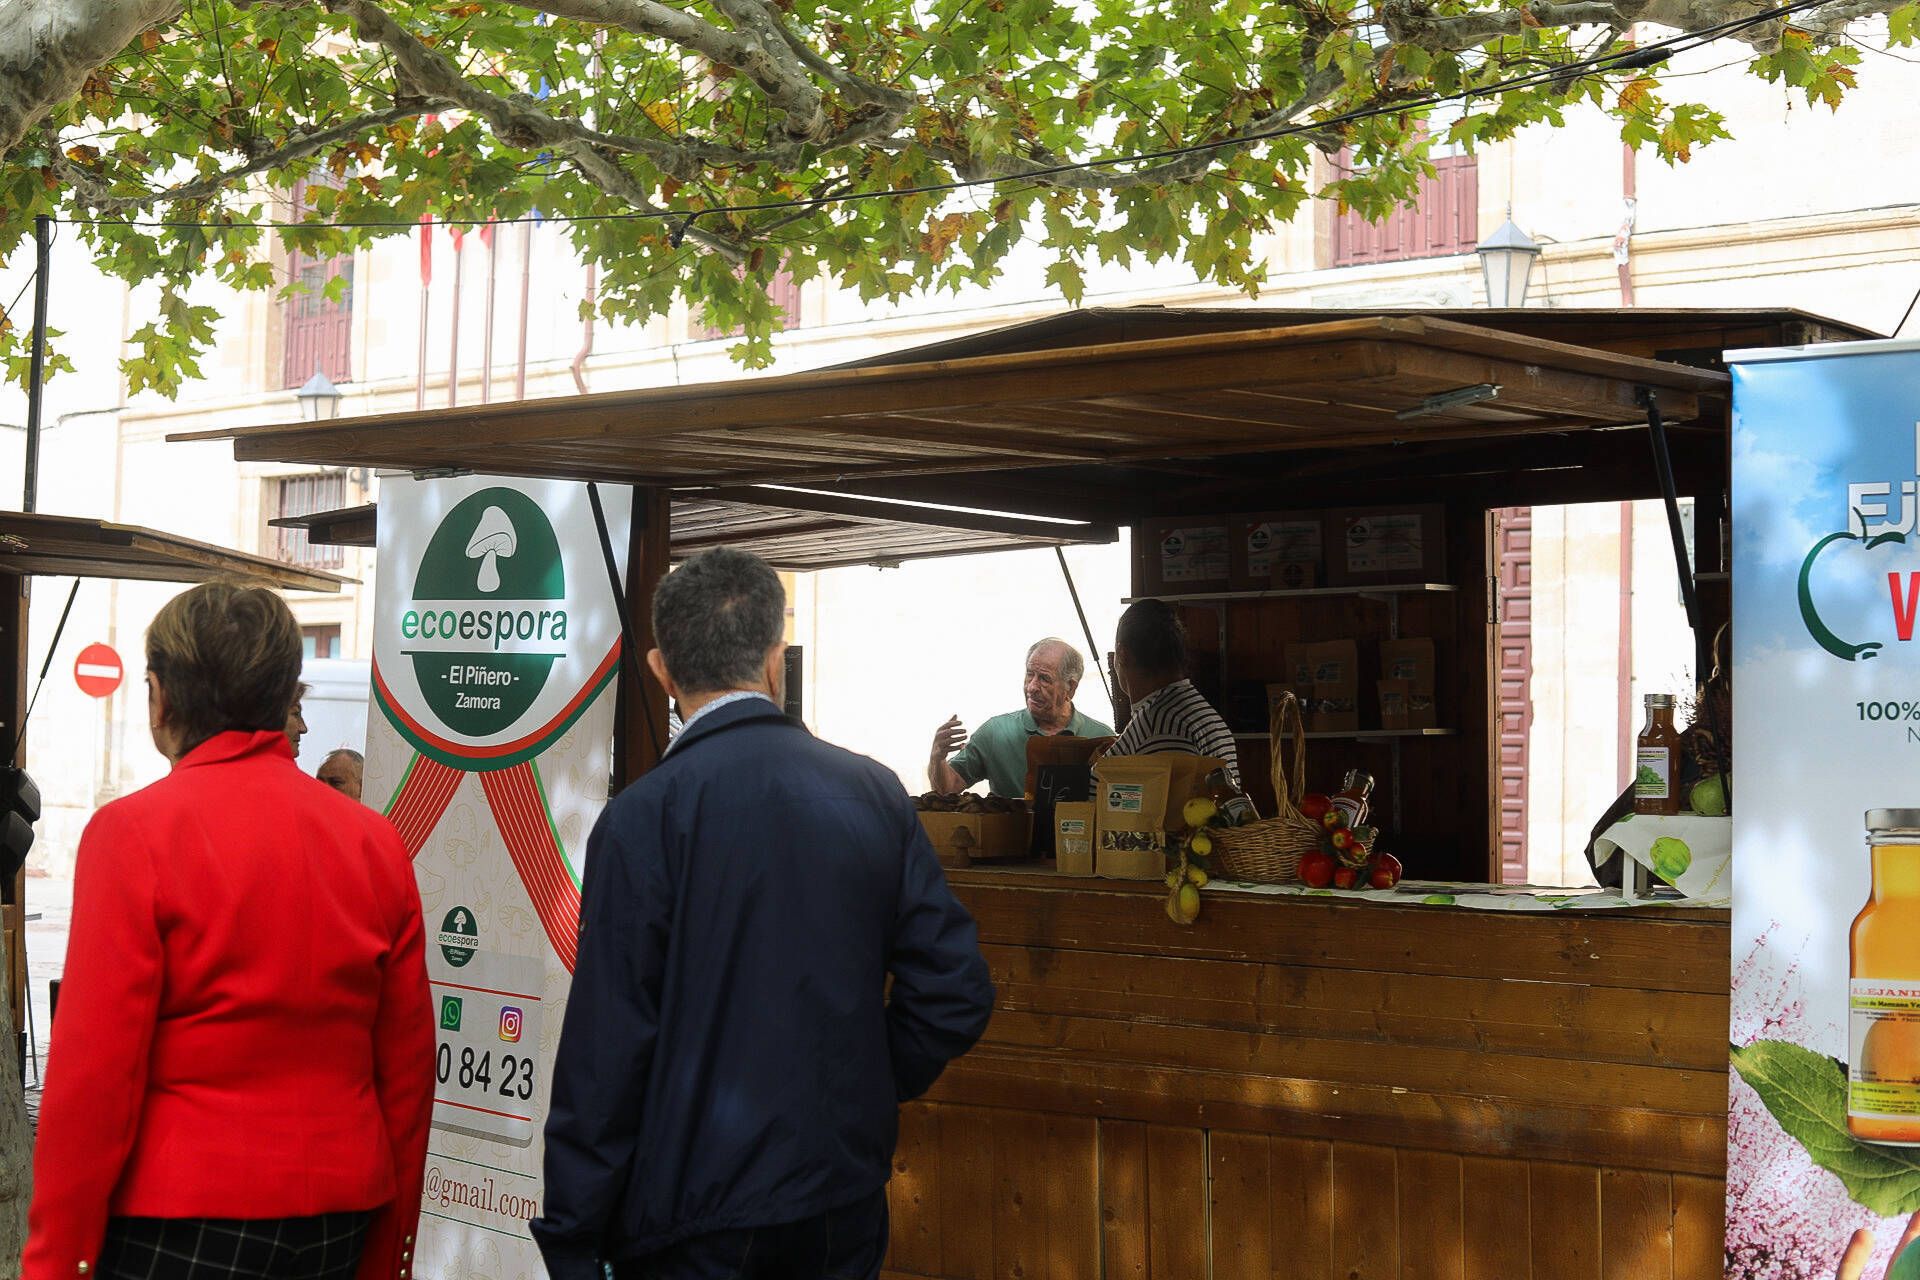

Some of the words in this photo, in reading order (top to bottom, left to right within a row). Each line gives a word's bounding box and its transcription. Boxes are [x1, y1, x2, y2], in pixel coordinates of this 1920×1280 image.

[1848, 480, 1920, 538] Ej
[401, 609, 567, 649] ecoespora
[449, 665, 465, 684] El
[465, 665, 511, 686] Piñero
[456, 692, 501, 710] Zamora
[1856, 702, 1920, 721] 100%
[438, 934, 479, 947] ecoespora
[458, 1046, 492, 1093] 84
[499, 1054, 534, 1101] 23
